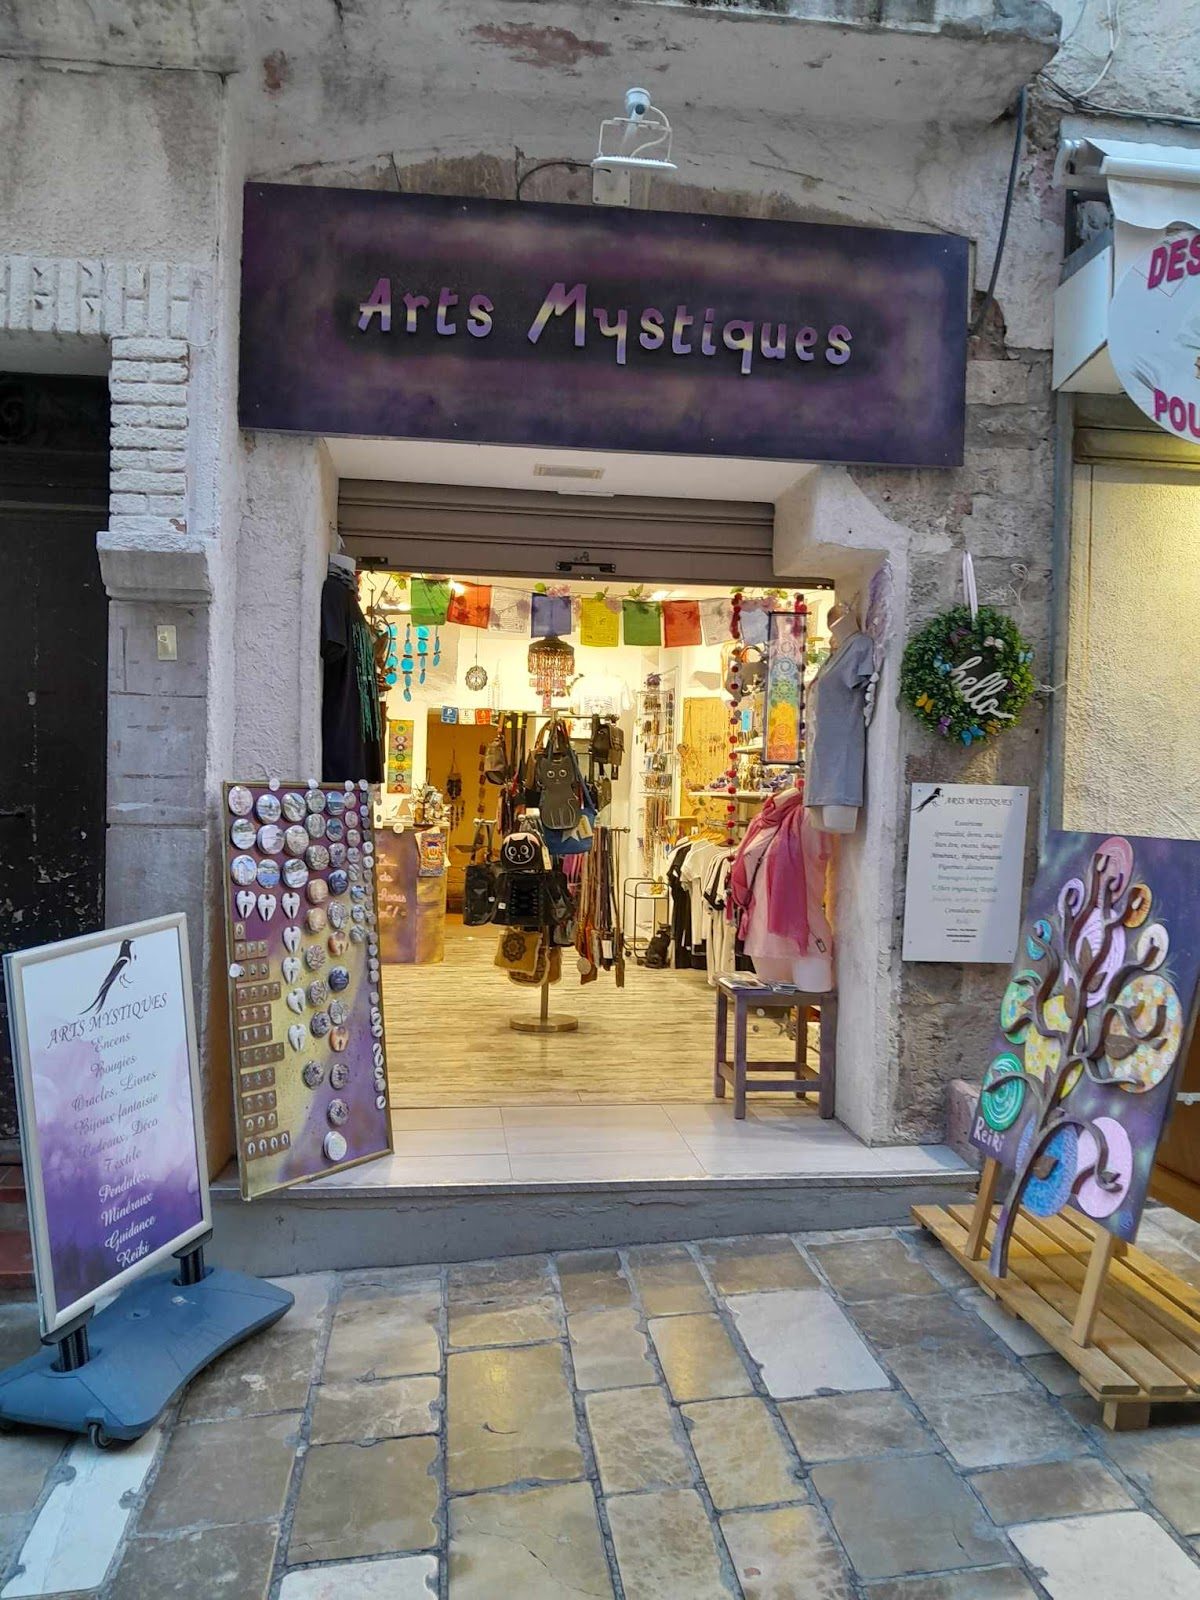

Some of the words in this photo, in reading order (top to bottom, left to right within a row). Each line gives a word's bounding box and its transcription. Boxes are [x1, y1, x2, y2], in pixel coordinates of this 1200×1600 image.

[357, 278, 494, 338] Arts
[527, 282, 853, 374] Mystiques
[949, 656, 1015, 719] hello
[46, 1019, 85, 1049] ARTS
[89, 992, 168, 1032] MYSTIQUES
[91, 1032, 131, 1053] Encens
[90, 1055, 137, 1078] Bougies
[71, 1085, 118, 1112] Oracles,
[74, 1112, 116, 1135] Bijoux
[117, 1092, 159, 1123] fantaisie
[975, 1115, 1005, 1152] Reiki
[104, 1146, 141, 1172] Textile
[101, 1192, 153, 1227] Minéraux
[104, 1215, 156, 1252] Guidance
